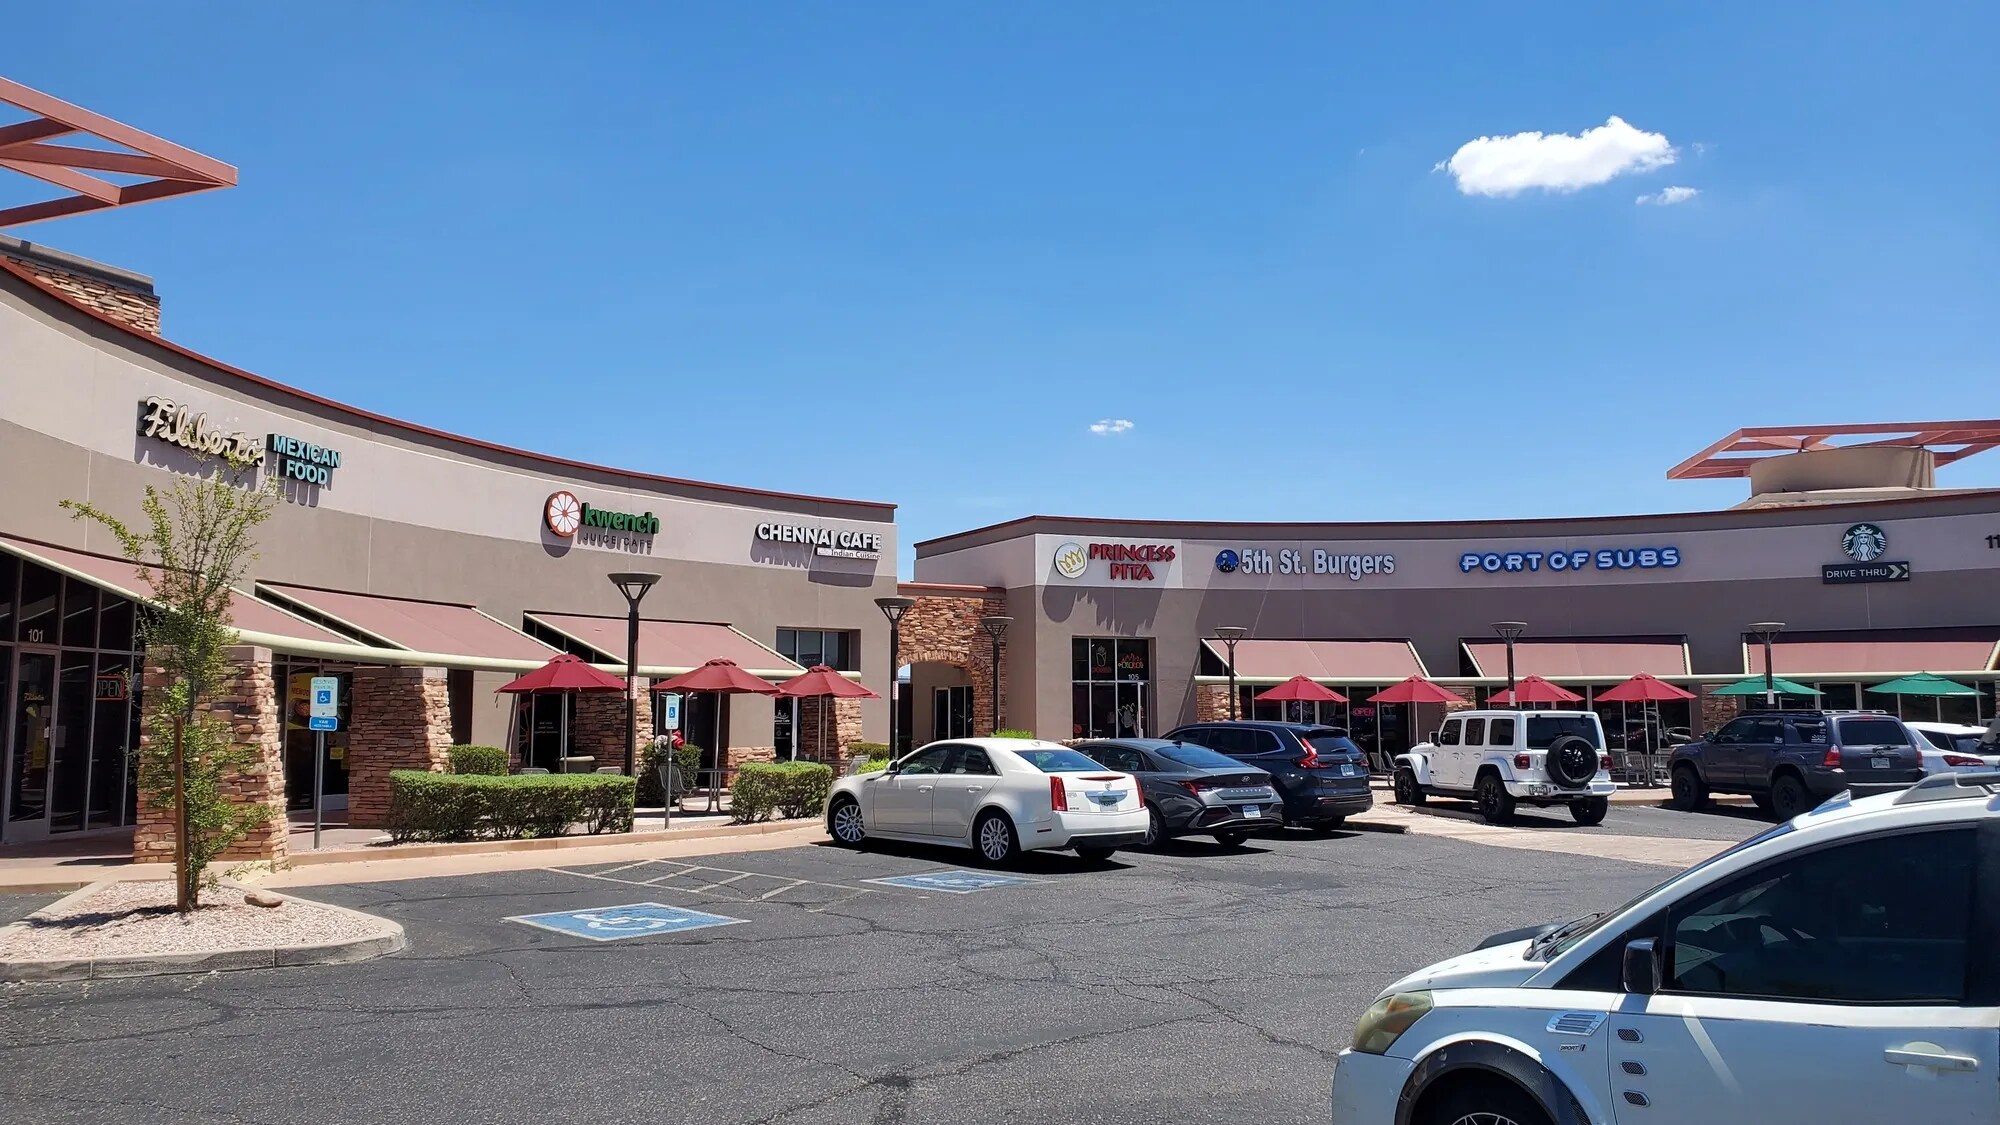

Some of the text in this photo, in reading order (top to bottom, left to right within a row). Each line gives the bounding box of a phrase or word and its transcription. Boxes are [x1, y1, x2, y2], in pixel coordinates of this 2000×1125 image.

[272, 433, 341, 468] MEXICAN
[286, 459, 328, 485] FOOD
[582, 502, 660, 534] kwench
[584, 533, 652, 549] JUICE CAFE
[757, 522, 882, 550] CHENNAI CAFE
[831, 549, 881, 560] Indian Cuisine
[1089, 543, 1176, 562] PRINCESS
[1460, 547, 1681, 573] PORT OF SUBS
[1110, 563, 1155, 581] PITA
[1241, 549, 1395, 581] 5th St. Burgers
[1826, 568, 1887, 579] DRIVE THRU
[28, 629, 44, 642] 101
[1353, 708, 1375, 716] OPEN
